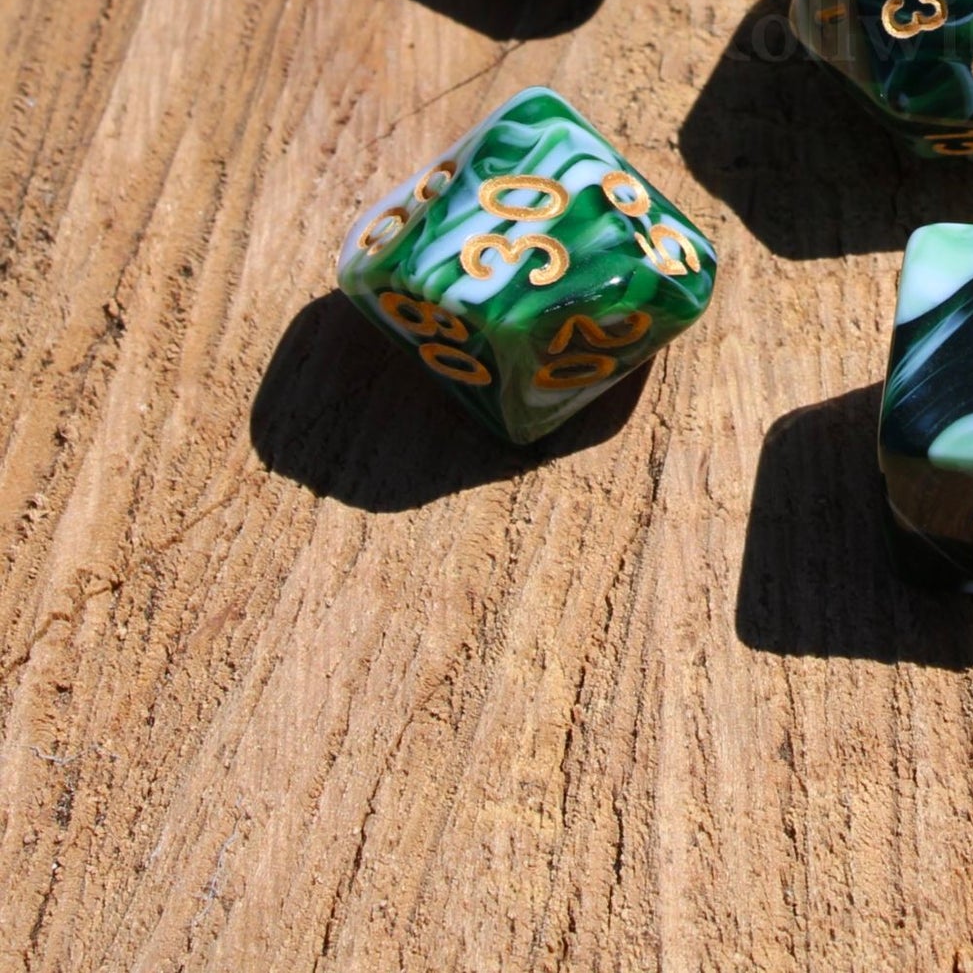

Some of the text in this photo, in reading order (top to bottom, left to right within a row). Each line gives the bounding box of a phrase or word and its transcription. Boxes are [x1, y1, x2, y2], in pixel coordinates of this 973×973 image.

[459, 174, 571, 287] 30
[601, 170, 702, 277] 50
[378, 291, 492, 387] 80
[531, 310, 653, 390] 20
